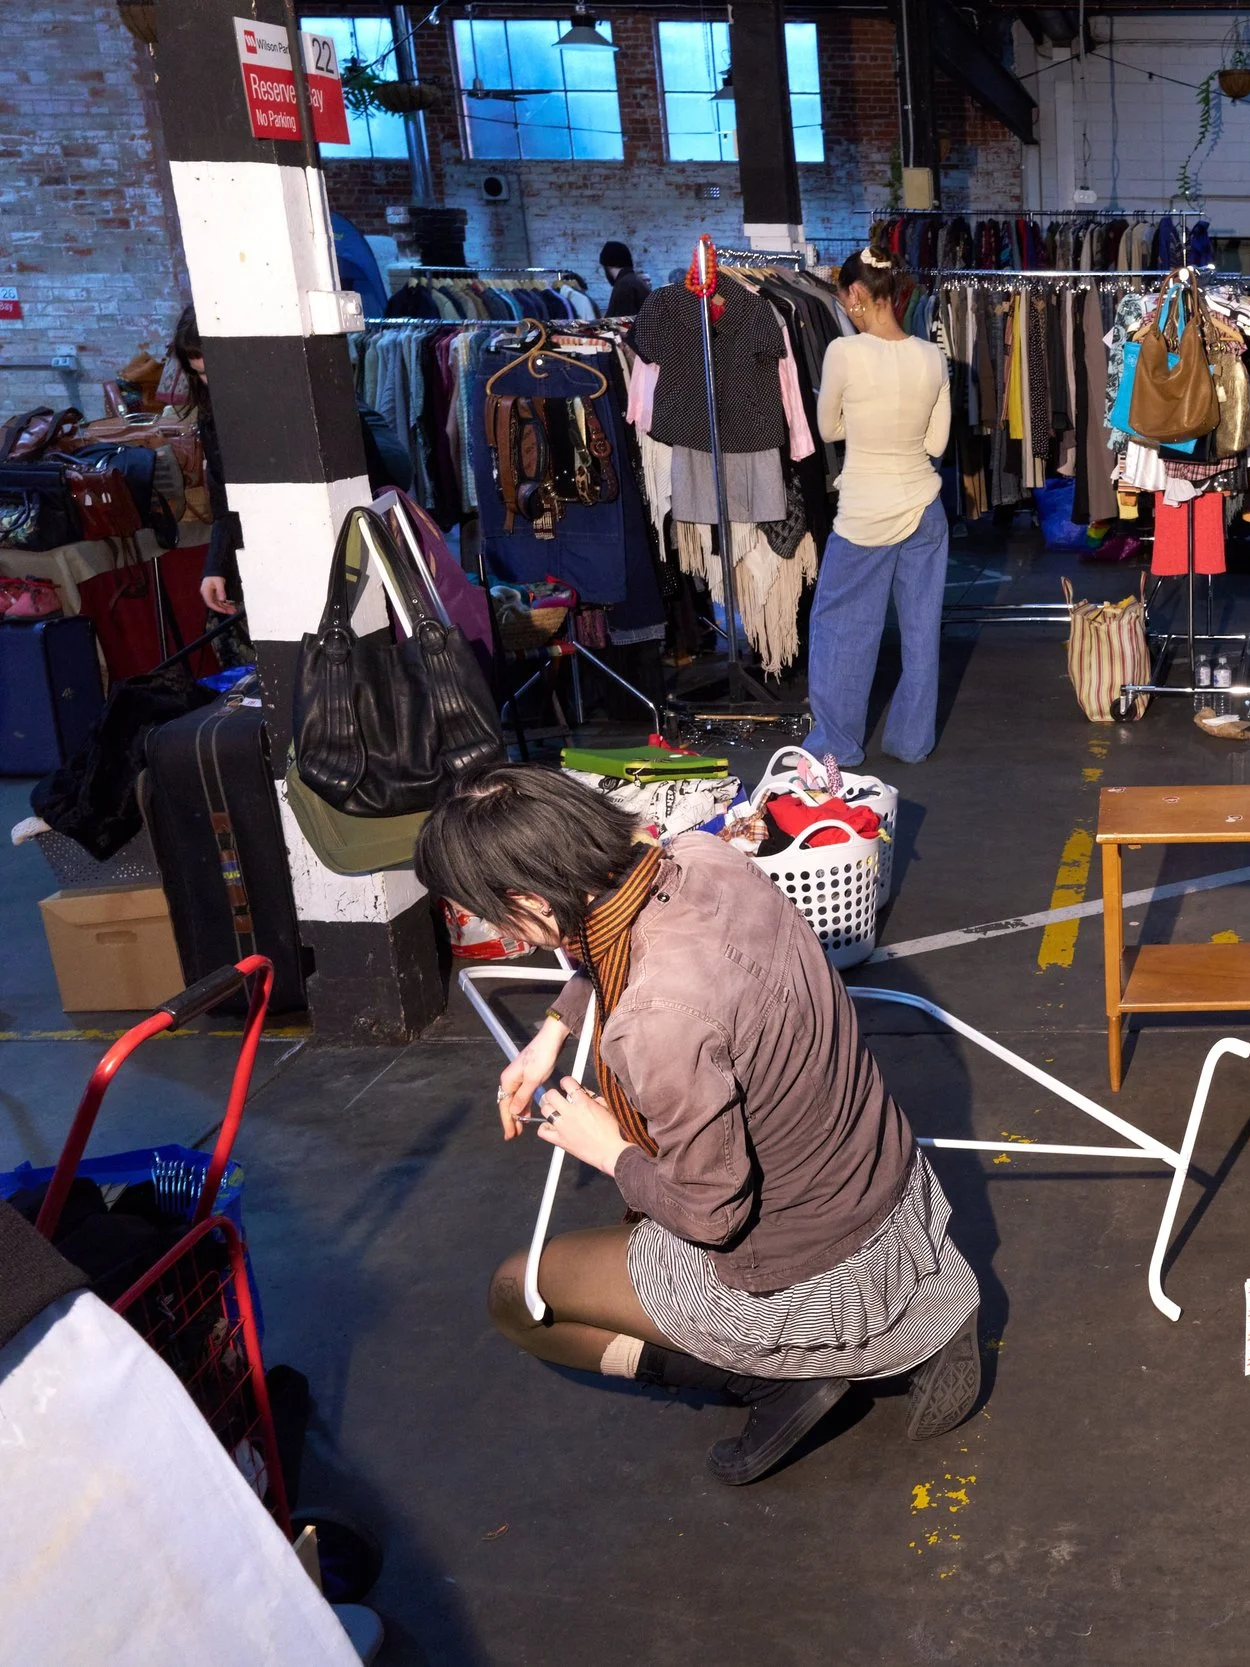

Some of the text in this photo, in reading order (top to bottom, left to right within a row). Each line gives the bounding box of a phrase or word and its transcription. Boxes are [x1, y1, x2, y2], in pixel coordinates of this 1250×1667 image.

[257, 38, 279, 53] Wilson
[312, 37, 335, 75] 22
[307, 84, 323, 112] ay
[256, 109, 297, 133] No Parking
[1, 288, 16, 299] 26
